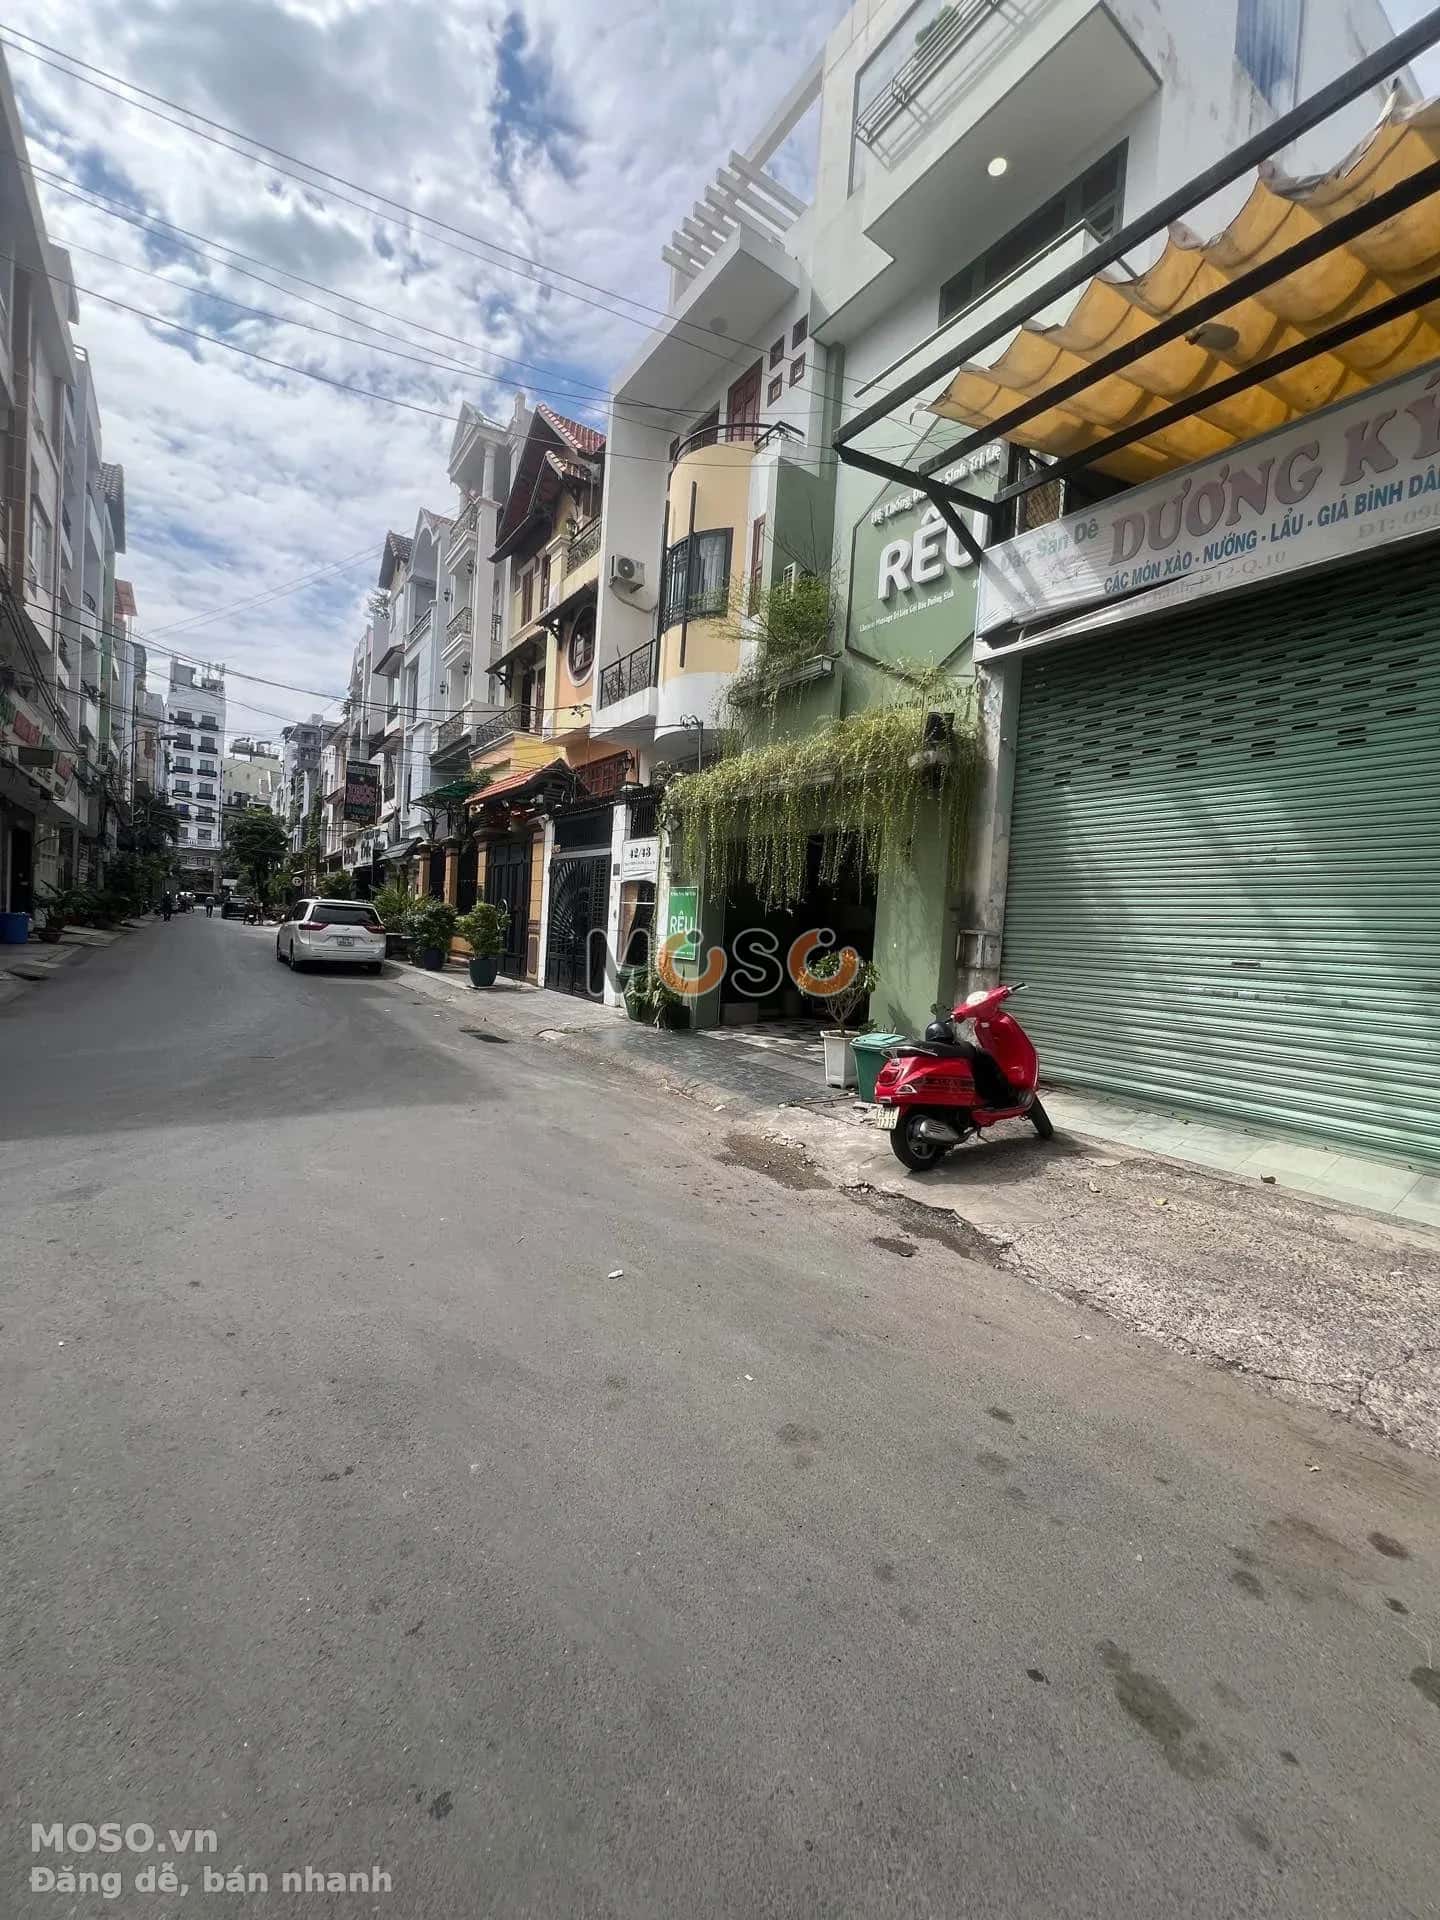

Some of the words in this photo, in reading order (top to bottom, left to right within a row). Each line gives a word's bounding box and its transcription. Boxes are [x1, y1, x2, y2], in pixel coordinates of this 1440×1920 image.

[878, 505, 988, 600] RÊU
[1074, 518, 1099, 544] Dê
[1104, 570, 1130, 594] CÁC
[1132, 561, 1161, 586] MÓN
[1162, 550, 1192, 575] XÀO
[1203, 528, 1257, 564] NƯỚNG
[1270, 507, 1303, 543] LẨU
[1317, 493, 1349, 529] GIÁ
[1355, 480, 1403, 515] BÌNH
[1109, 440, 1324, 566] DƯƠNG
